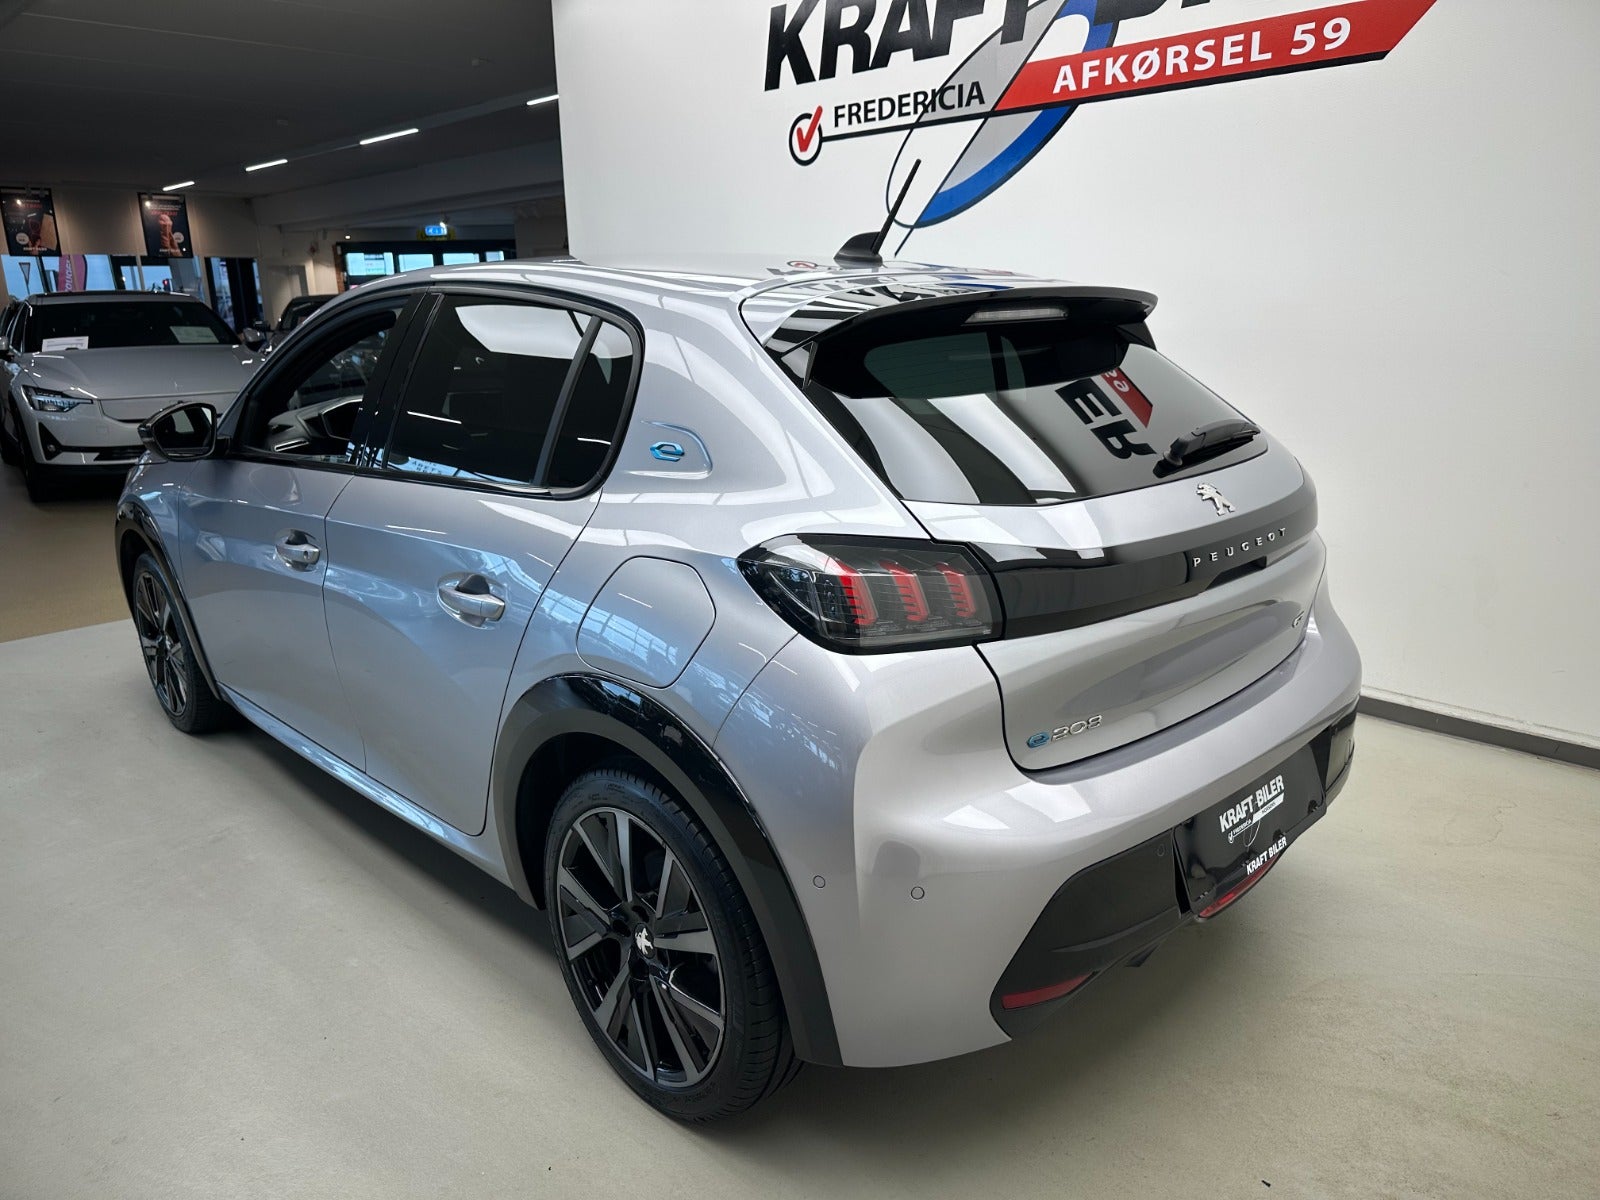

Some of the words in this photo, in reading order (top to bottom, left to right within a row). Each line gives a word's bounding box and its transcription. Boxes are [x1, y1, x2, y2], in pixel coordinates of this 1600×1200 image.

[1053, 30, 1272, 94] AFKØRSEL
[1290, 17, 1352, 56] 59
[834, 81, 985, 128] FREDERICIA
[1192, 527, 1287, 568] PEUGEOT
[1219, 794, 1255, 833] KRAFT
[1255, 774, 1285, 807] BILER
[1246, 850, 1269, 876] KRAFT
[1268, 836, 1288, 859] BILER
